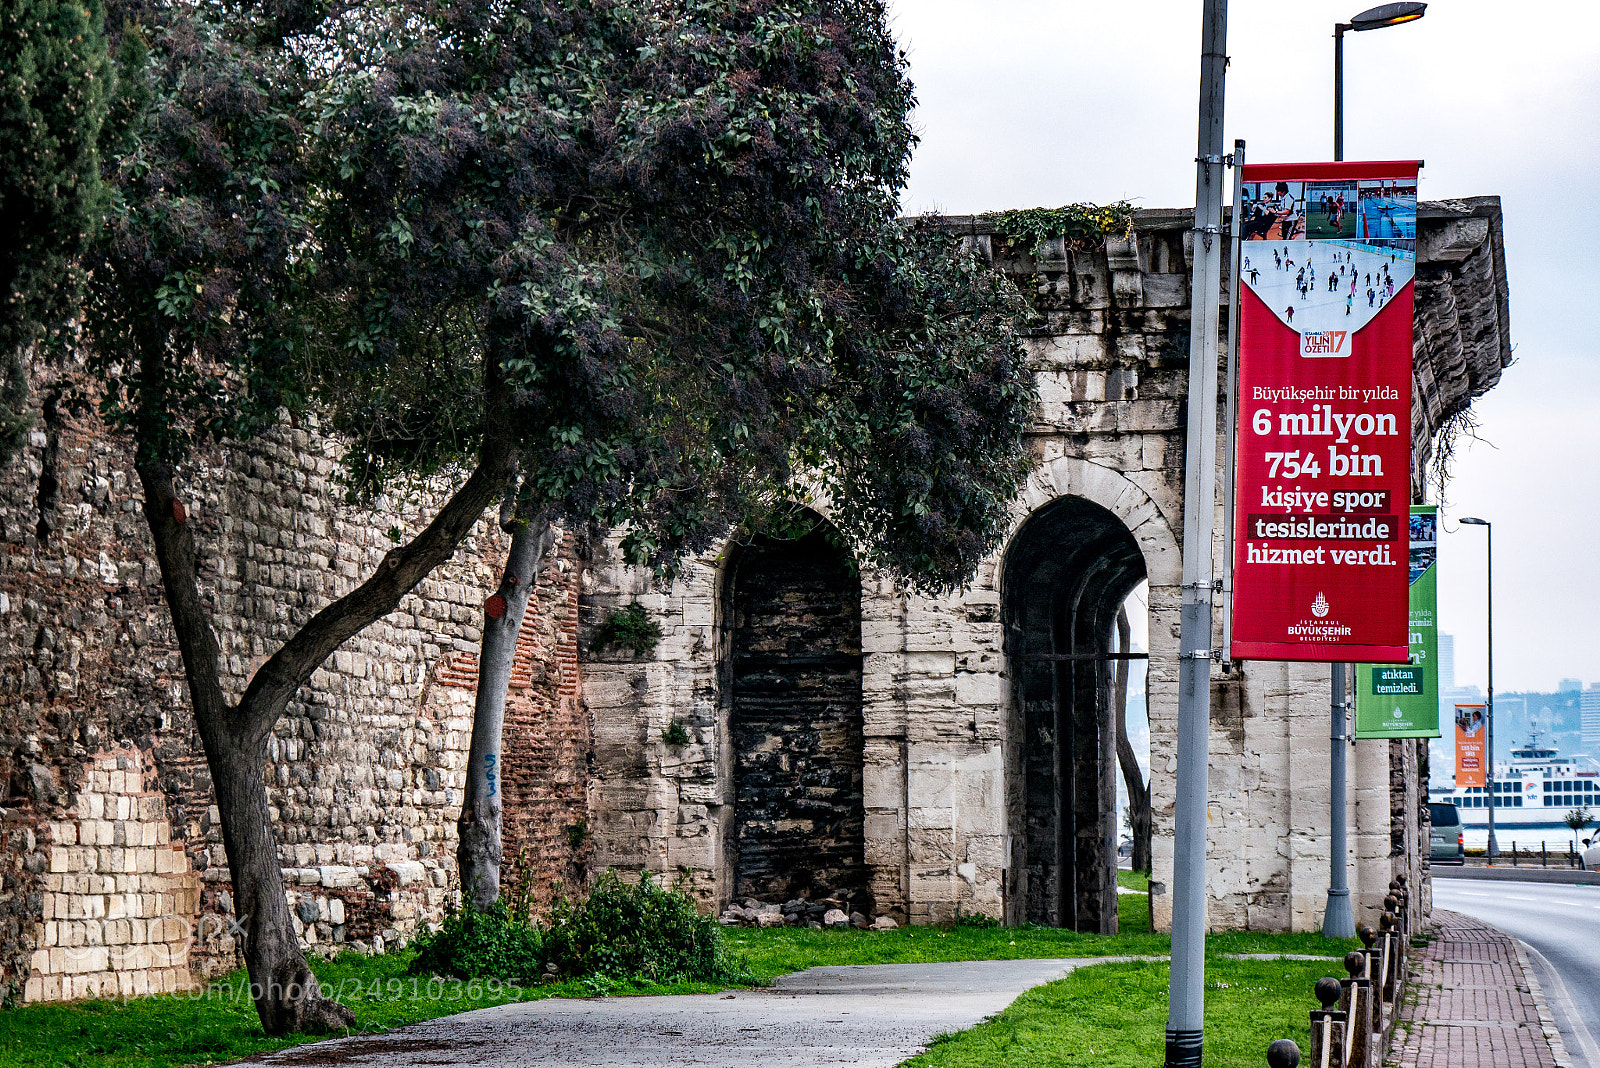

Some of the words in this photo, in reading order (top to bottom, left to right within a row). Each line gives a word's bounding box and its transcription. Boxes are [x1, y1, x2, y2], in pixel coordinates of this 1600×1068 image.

[1252, 386, 1335, 403] Büyükşehir
[1339, 386, 1359, 400] bir
[1363, 386, 1399, 403] yılda
[1252, 408, 1272, 436] 6
[1278, 404, 1398, 443] milyon
[1264, 449, 1321, 478] 754
[1328, 445, 1384, 476] bin
[1261, 485, 1329, 513] kişiye
[1333, 491, 1386, 512] spor
[1255, 516, 1390, 539] tesislerinde
[1247, 543, 1326, 565] hizmet
[1330, 544, 1397, 566] verdi.
[1287, 624, 1352, 637] BÜYÜKŞEHİR
[1381, 669, 1414, 680] atıktan
